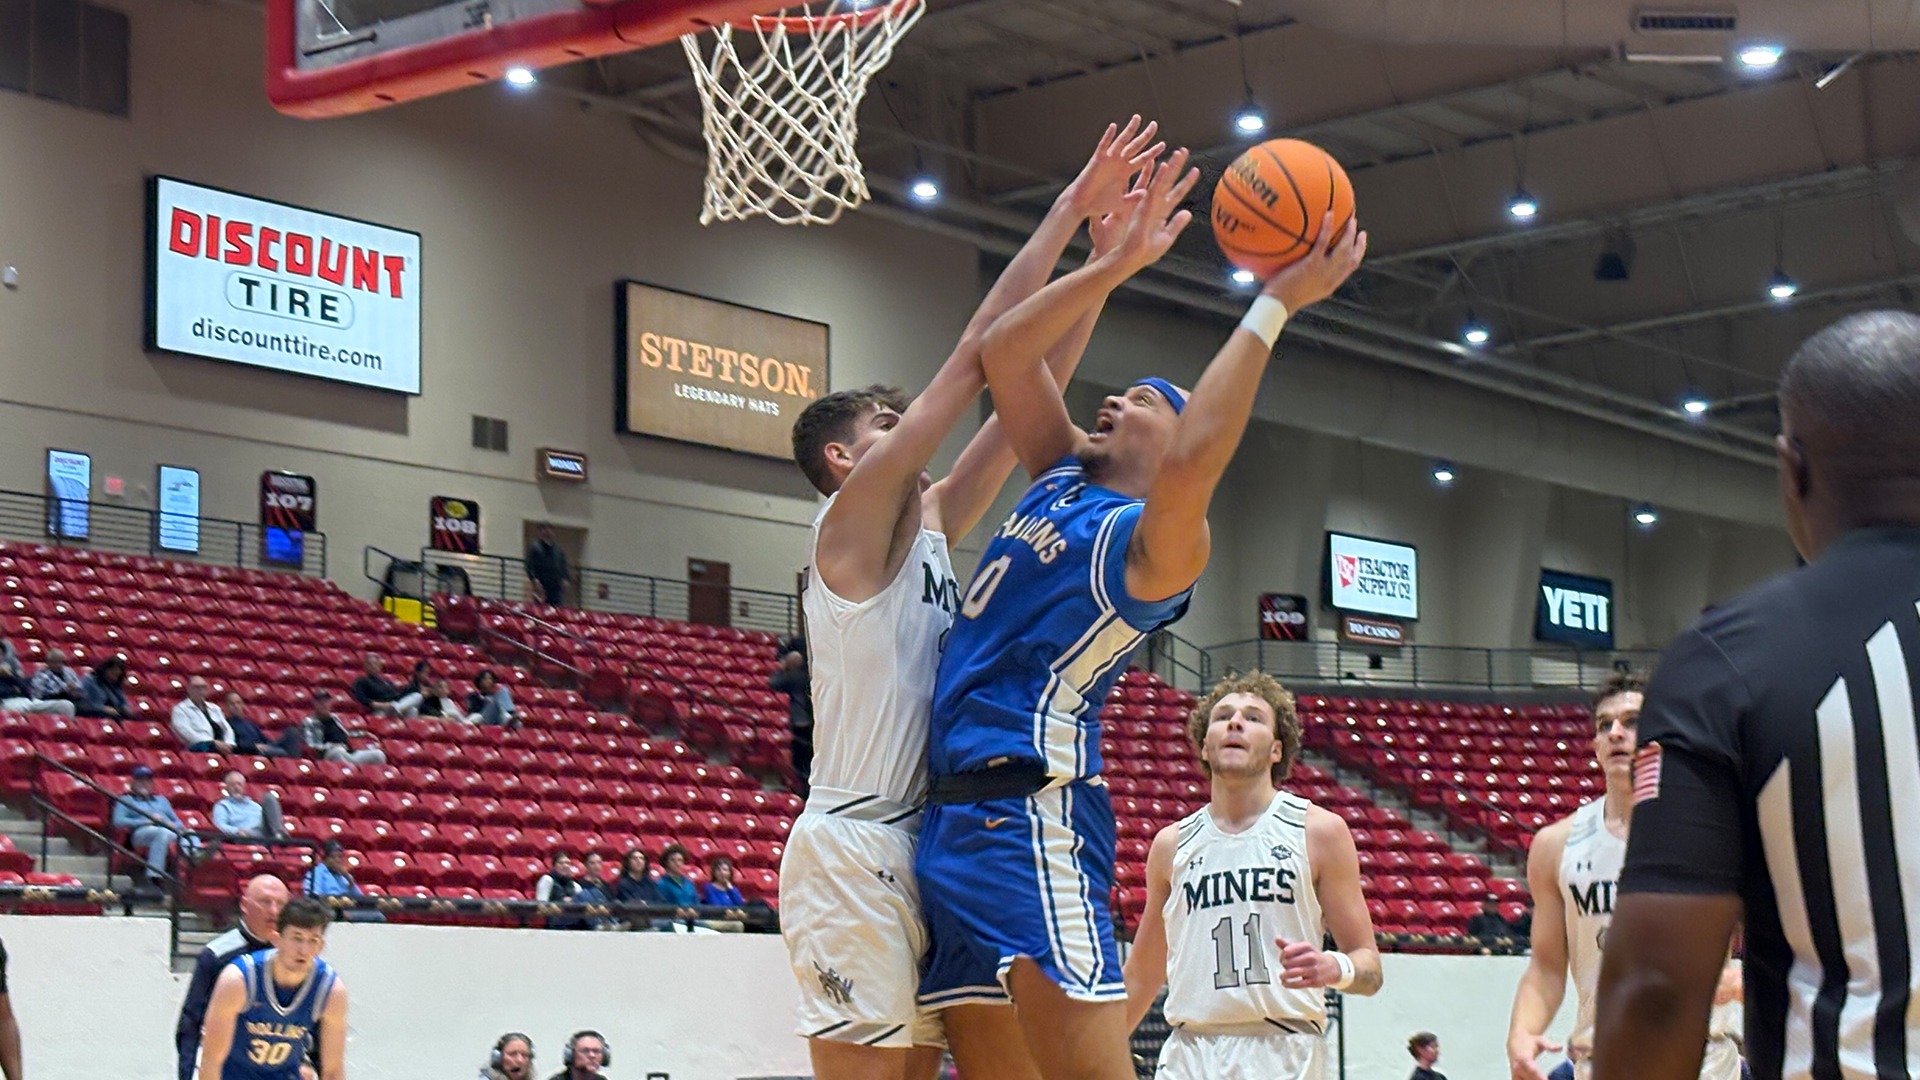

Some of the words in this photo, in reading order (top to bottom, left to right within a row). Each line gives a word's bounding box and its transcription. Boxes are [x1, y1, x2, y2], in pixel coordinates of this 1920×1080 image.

[169, 206, 406, 299] DISCOUNT
[238, 277, 340, 323] TIRE
[192, 317, 383, 371] discounttire.com
[674, 382, 746, 410] LEGENDARY
[748, 397, 780, 417] HATS
[266, 492, 312, 511] 107
[434, 516, 477, 534] 108
[995, 511, 1067, 565] OLLINS
[1357, 576, 1397, 598] SUPPLY
[1358, 557, 1409, 581] TRACTOR
[1262, 610, 1306, 625] 109
[1542, 585, 1609, 633] YETI
[1183, 867, 1296, 915] MINES
[1569, 880, 1618, 917] MI
[1211, 912, 1271, 989] 11
[247, 1039, 292, 1065] 30
